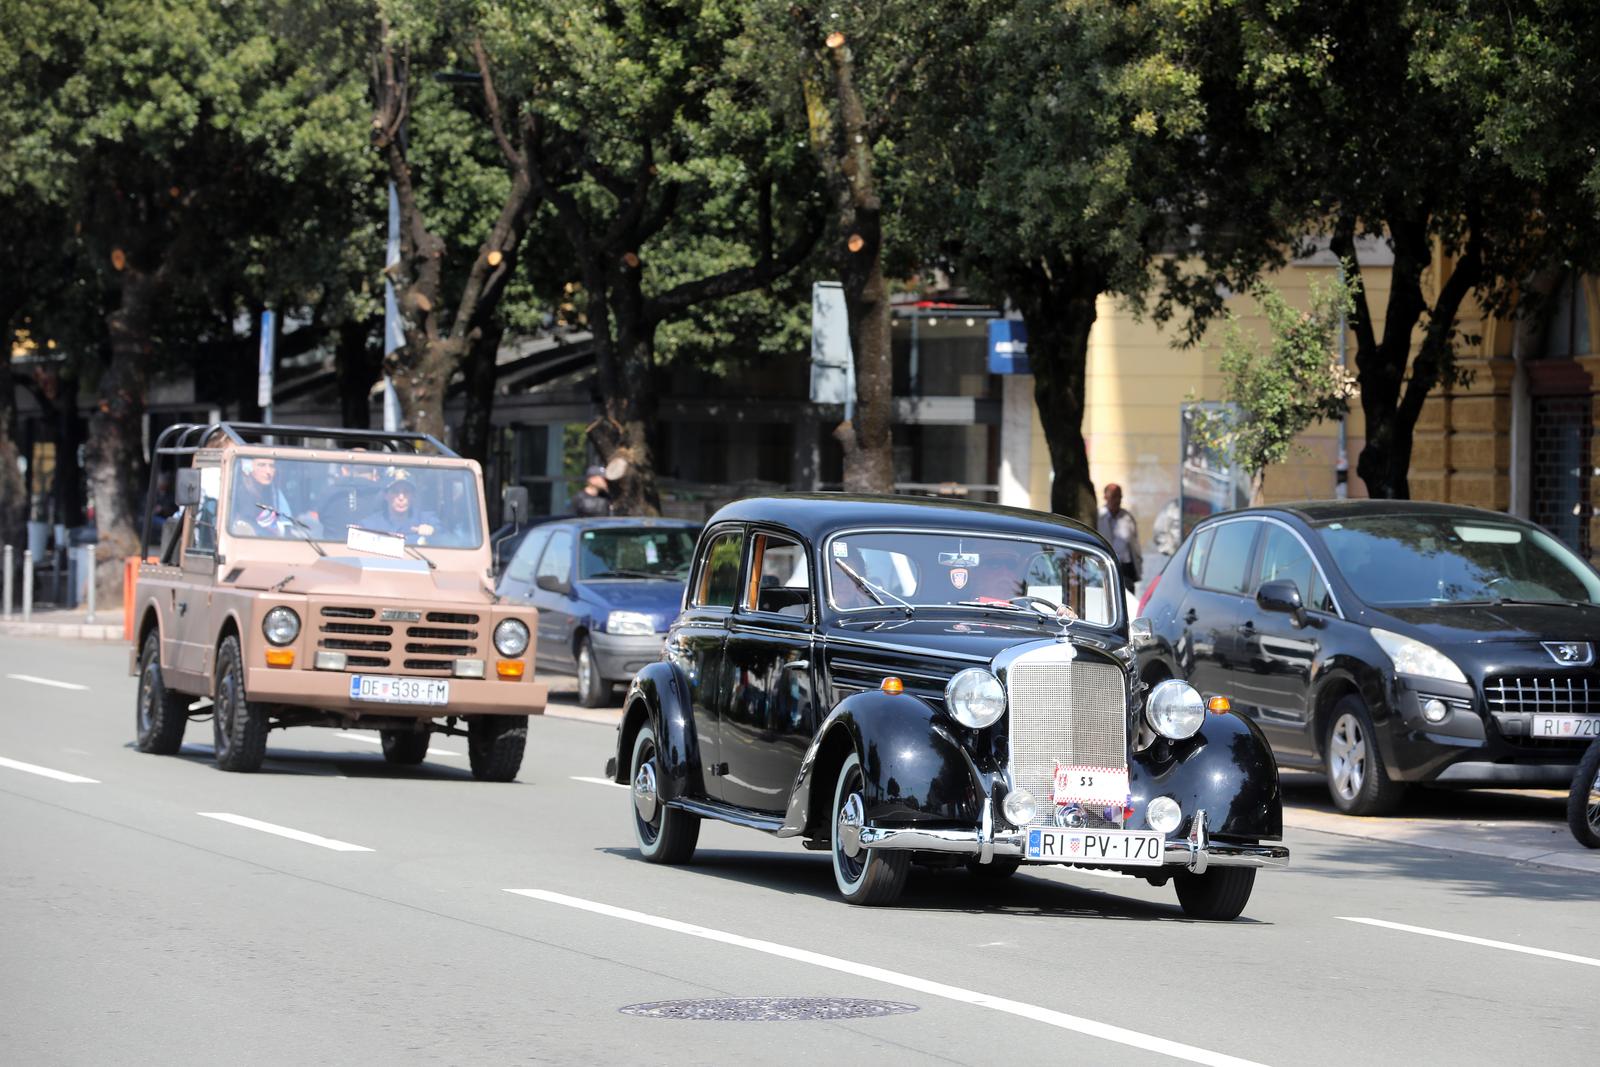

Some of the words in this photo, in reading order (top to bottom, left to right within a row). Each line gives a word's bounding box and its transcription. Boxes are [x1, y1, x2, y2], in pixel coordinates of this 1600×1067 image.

[361, 680, 379, 696] DE
[391, 682, 446, 699] 538-FM
[1544, 719, 1560, 735] RI
[1080, 776, 1094, 787] 53
[1029, 846, 1041, 854] HR
[1043, 834, 1064, 856] RI
[1084, 835, 1159, 859] PV-170
